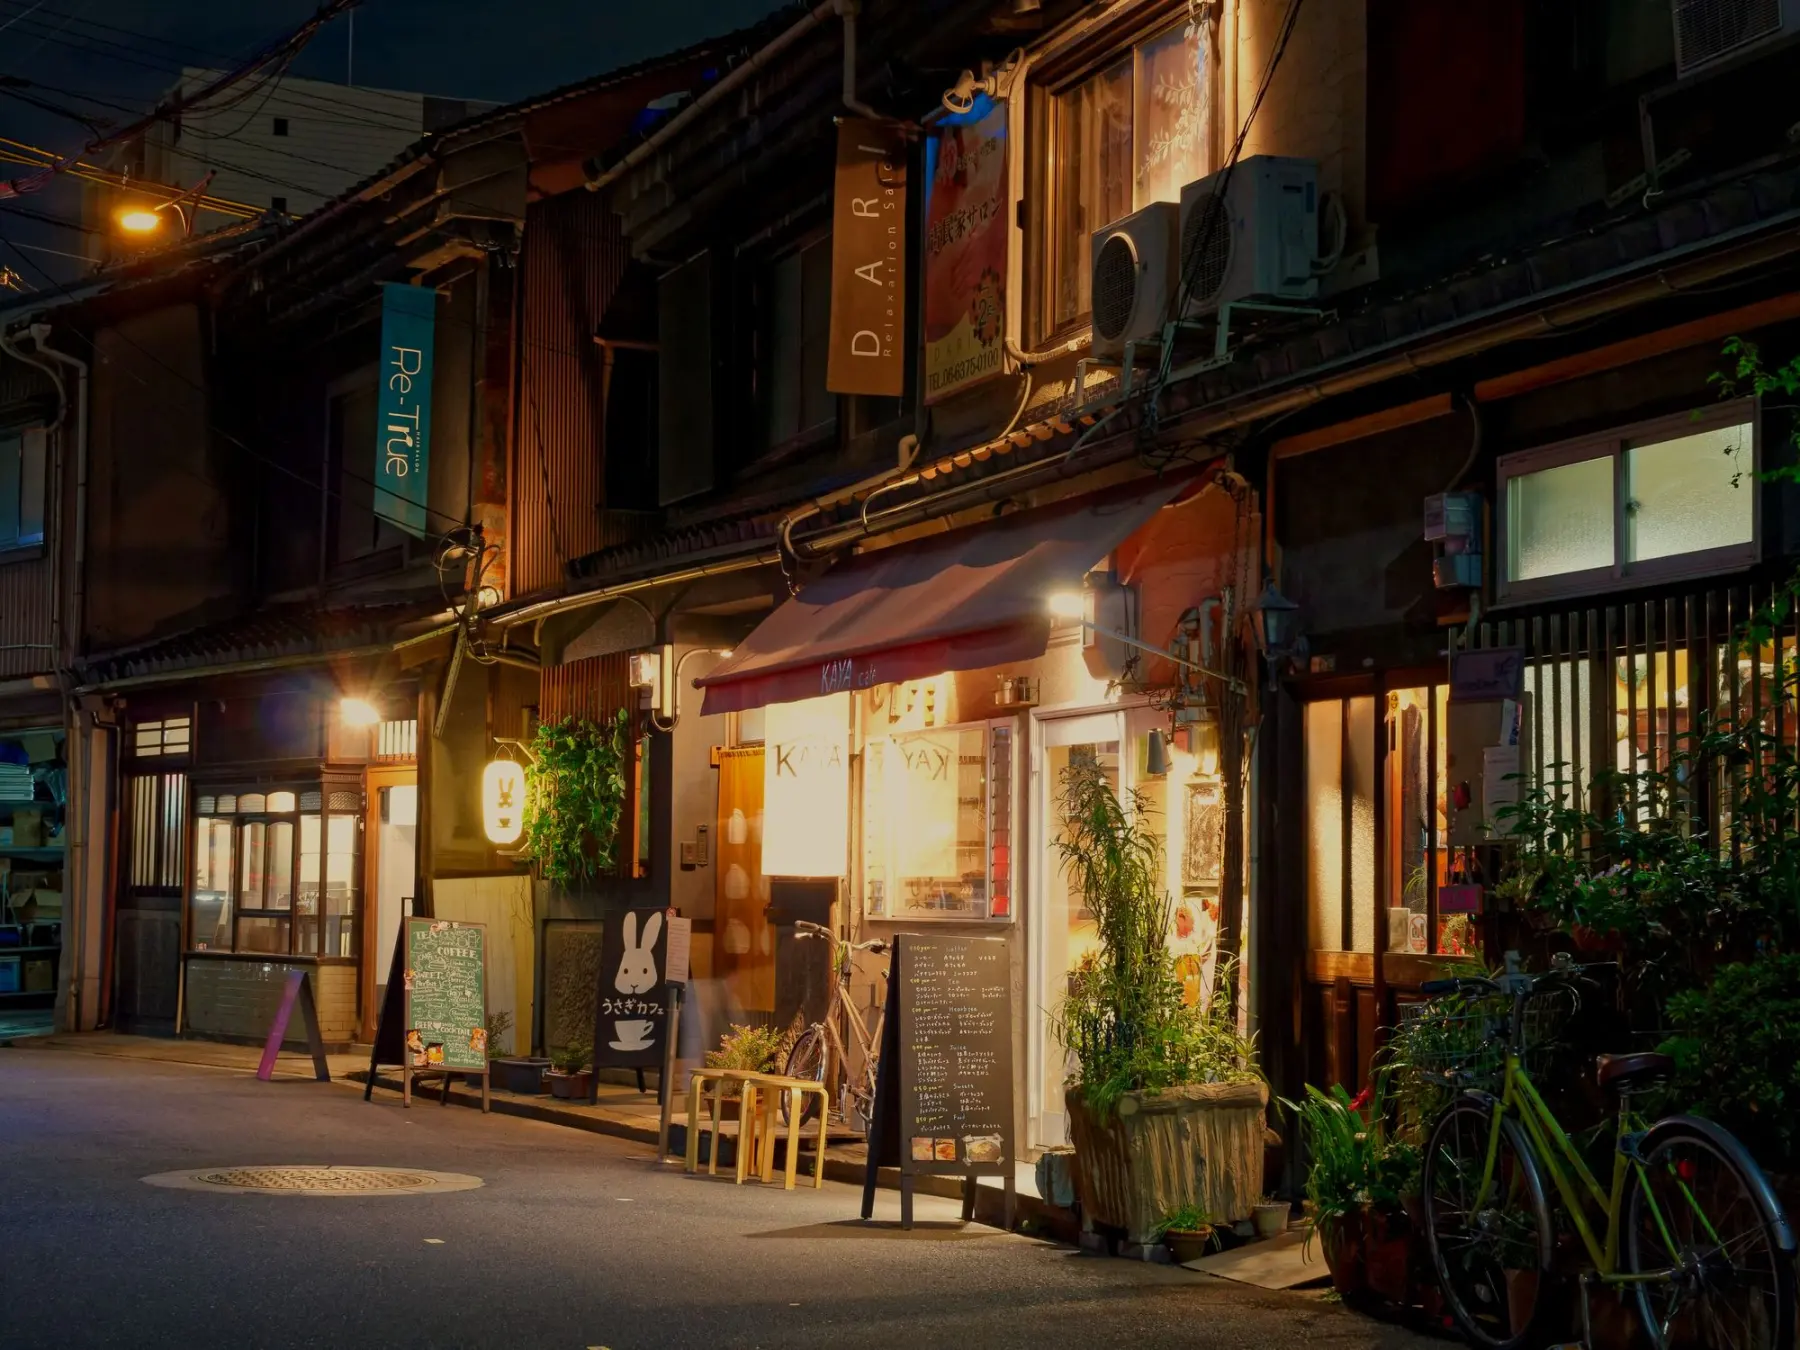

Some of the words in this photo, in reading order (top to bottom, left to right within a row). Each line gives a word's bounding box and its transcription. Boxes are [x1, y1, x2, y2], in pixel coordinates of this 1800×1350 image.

[851, 144, 887, 357] DARI
[883, 226, 897, 357] Relaxation
[820, 658, 852, 693] KAYA
[437, 946, 477, 960] COFFEE
[602, 998, 665, 1015] うさぎカフェ
[414, 1020, 434, 1030] BEER
[440, 1026, 471, 1036] COCKTAIL
